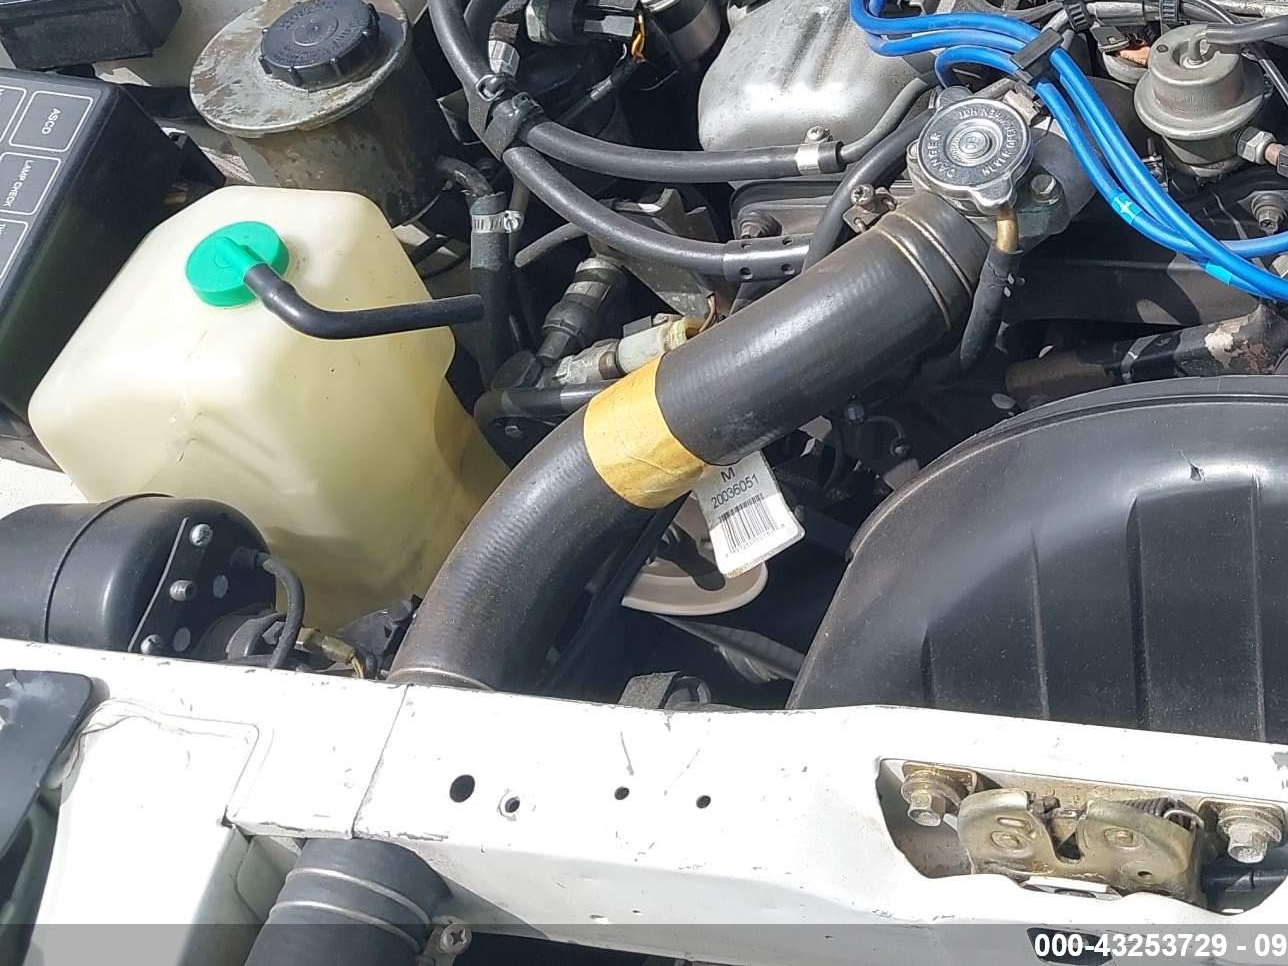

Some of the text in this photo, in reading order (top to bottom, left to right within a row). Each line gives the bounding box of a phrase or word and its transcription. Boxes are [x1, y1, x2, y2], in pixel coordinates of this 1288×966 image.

[42, 107, 61, 135] ASCD
[928, 132, 956, 178] DANGER
[4, 159, 34, 208] LAMP CHECK
[711, 474, 759, 508] 20036051
[720, 467, 735, 482] M
